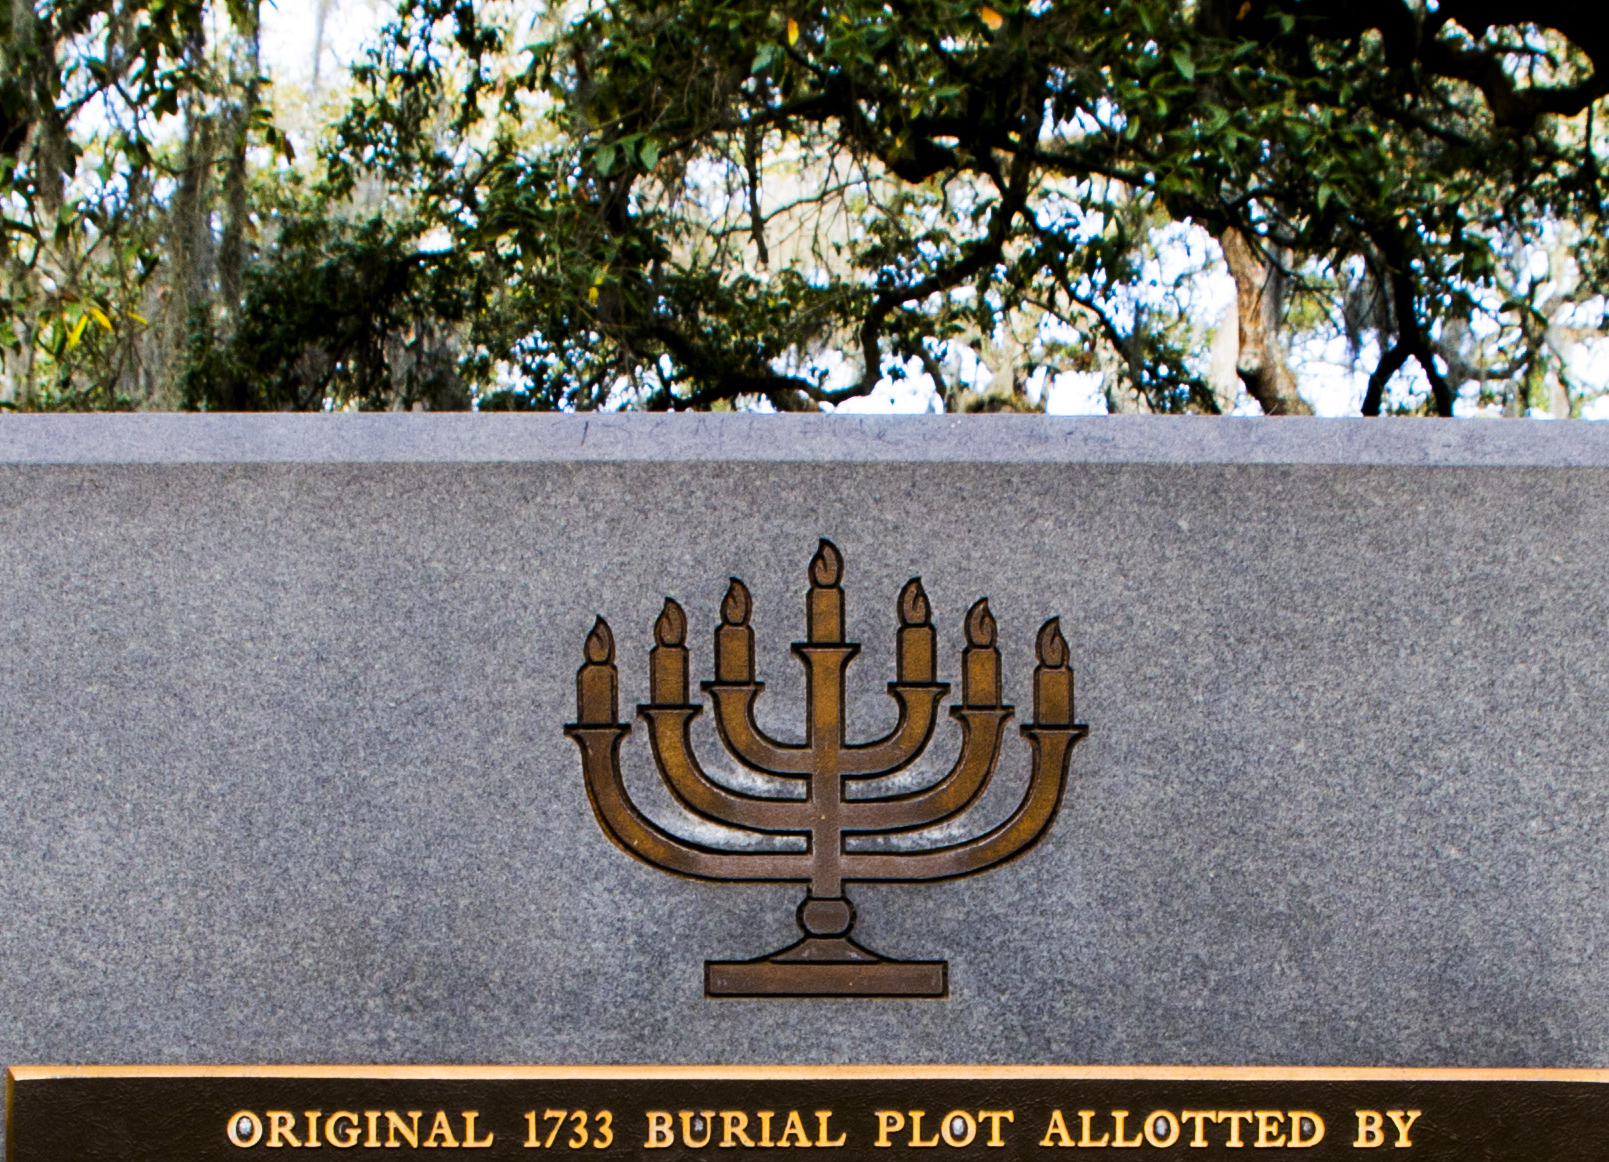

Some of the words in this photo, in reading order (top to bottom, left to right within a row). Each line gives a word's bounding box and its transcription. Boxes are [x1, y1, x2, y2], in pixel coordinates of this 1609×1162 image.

[225, 1109, 496, 1149] ORIGINAL
[522, 1108, 615, 1149] 1733
[642, 1109, 848, 1149] BURIAL
[872, 1109, 1016, 1148] PLOT
[1037, 1109, 1327, 1149] ALLOTTED
[1351, 1109, 1424, 1148] BY
